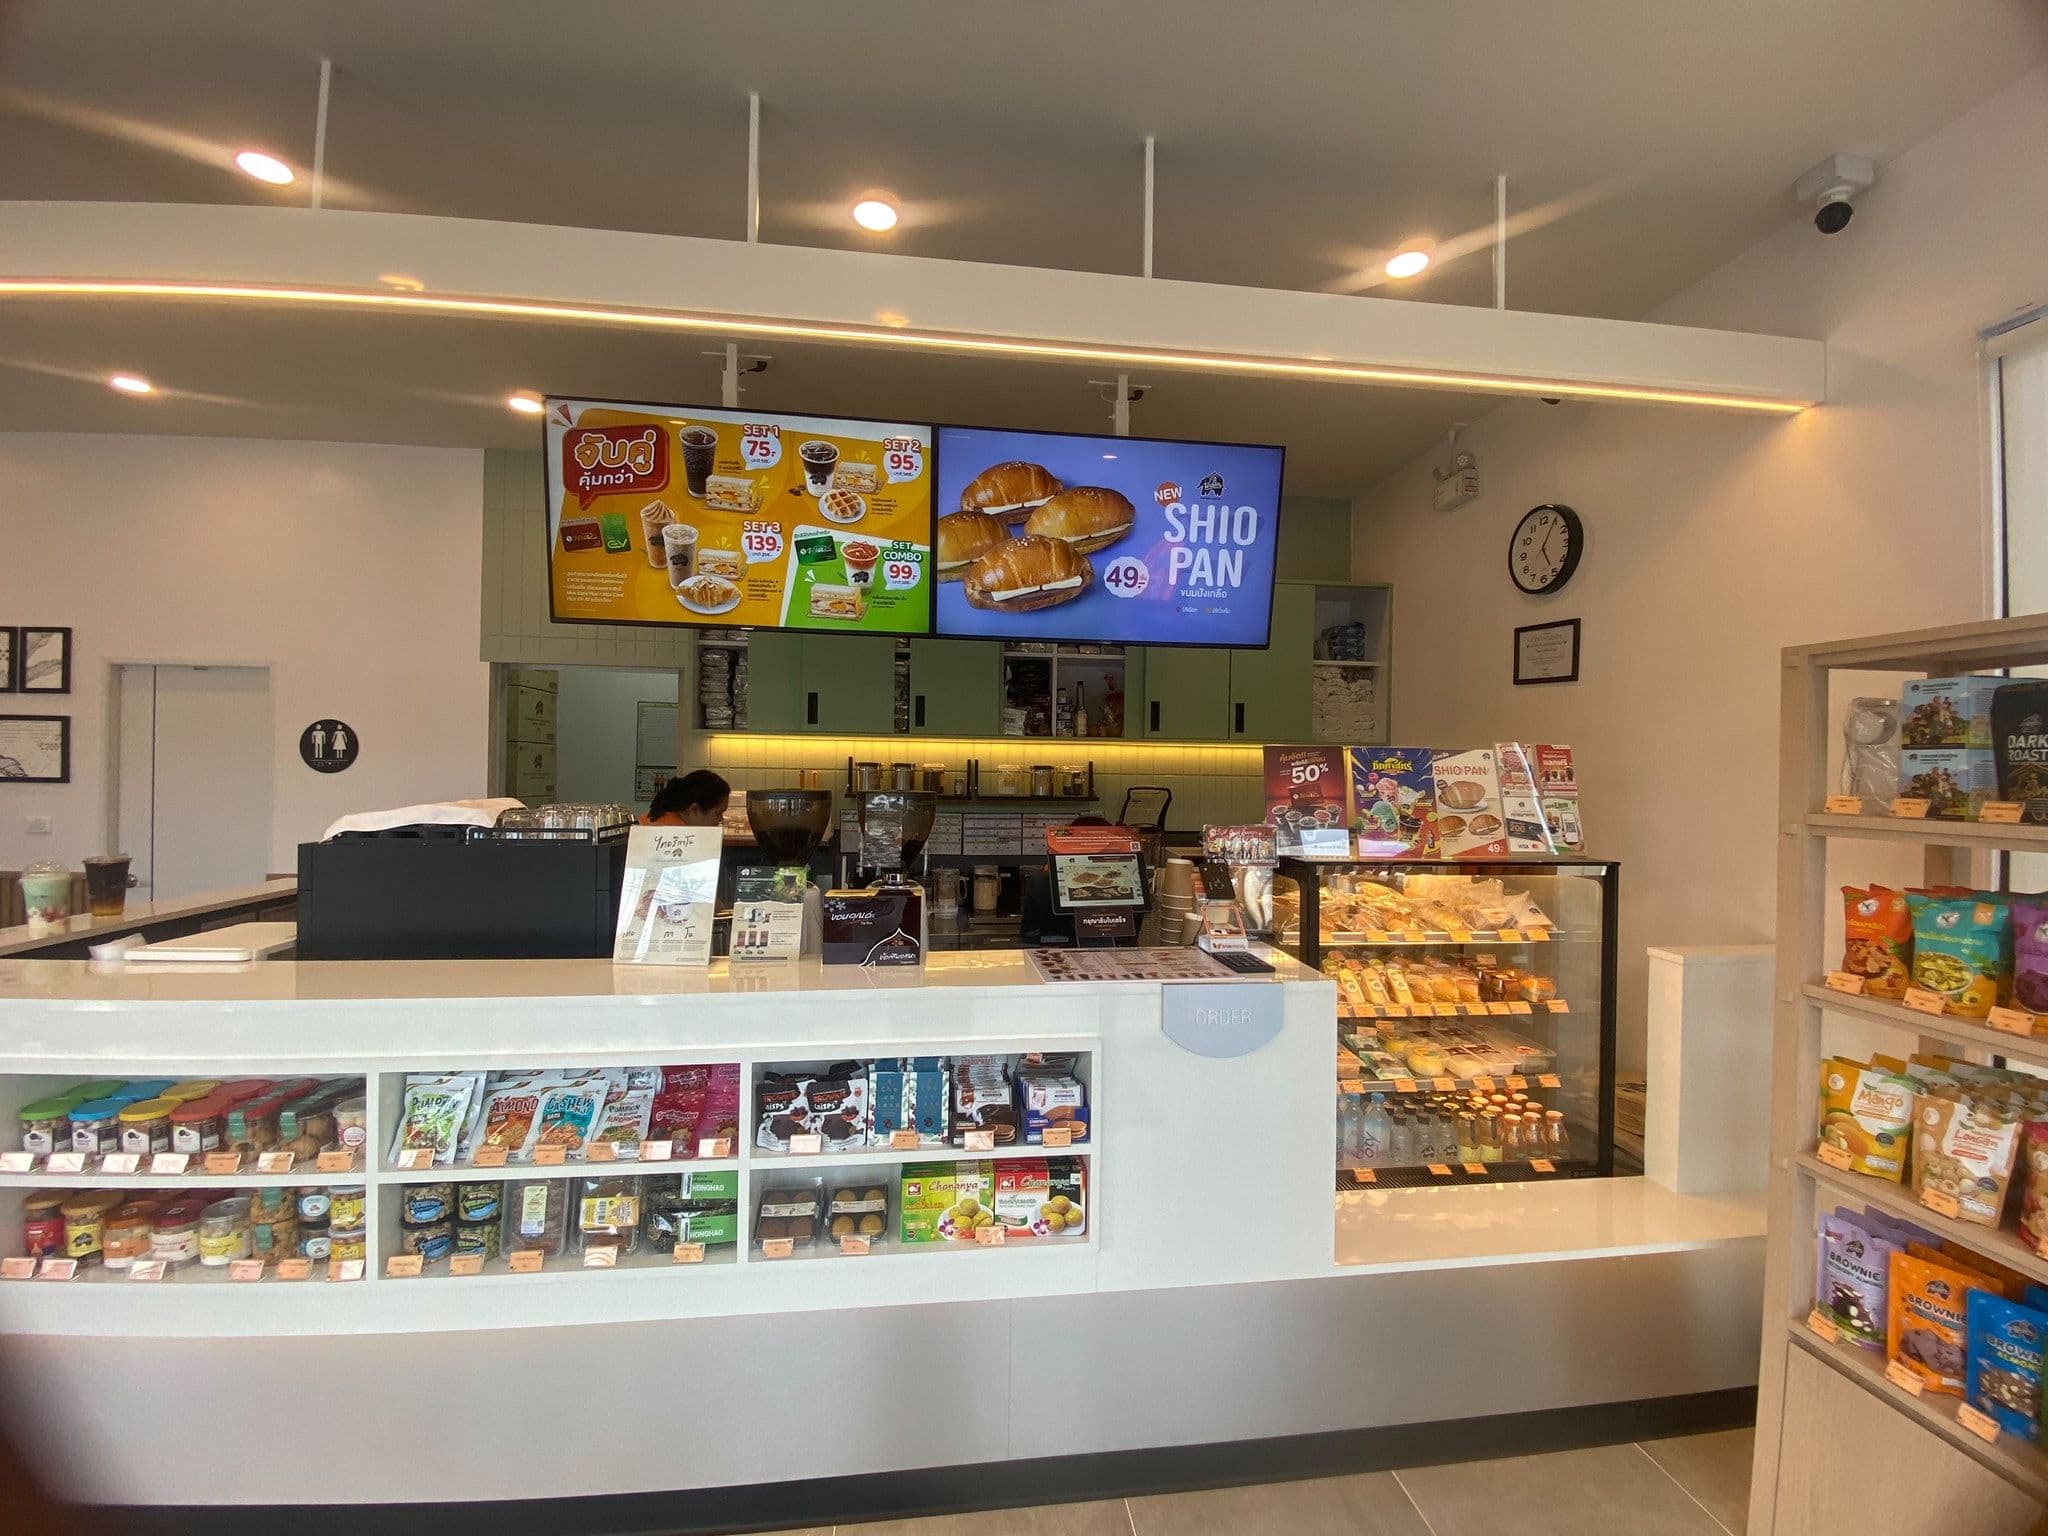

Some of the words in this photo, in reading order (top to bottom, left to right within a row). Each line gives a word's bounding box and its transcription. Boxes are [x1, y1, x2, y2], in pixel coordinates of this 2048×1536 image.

[743, 424, 767, 437] SET
[772, 426, 780, 438] 1
[883, 439, 908, 452] SET
[911, 440, 921, 453] 2
[575, 429, 656, 476] จับคู่
[579, 472, 634, 493] คุ้มกว่า
[1154, 485, 1183, 502] NEW
[743, 521, 767, 533] SET
[769, 521, 781, 533] 3
[1164, 502, 1258, 545] SHIO
[1540, 516, 1548, 526] 12
[1531, 524, 1537, 534] 11
[1560, 525, 1567, 534] 2
[892, 541, 913, 550] SET
[1523, 537, 1532, 547] 10
[883, 551, 922, 563] COMBO
[1520, 552, 1527, 561] 9
[1168, 547, 1243, 588] PAN
[1523, 565, 1529, 574] 8
[1530, 574, 1536, 582] 7
[1540, 575, 1548, 584] 6
[1180, 588, 1228, 599] ขนมปังเกลือ
[2008, 735, 2048, 749] DARK
[1434, 765, 1463, 776] SHIO
[1465, 766, 1487, 776] PAN
[1194, 1008, 1252, 1025] ORDER
[490, 1096, 539, 1113] ALMOND
[546, 1094, 595, 1112] CASHEW
[1858, 1089, 1904, 1110] Mango
[692, 1183, 725, 1192] HONGHAO
[689, 1229, 723, 1239] HONGHAO
[1830, 1252, 1880, 1281] BROWNIE
